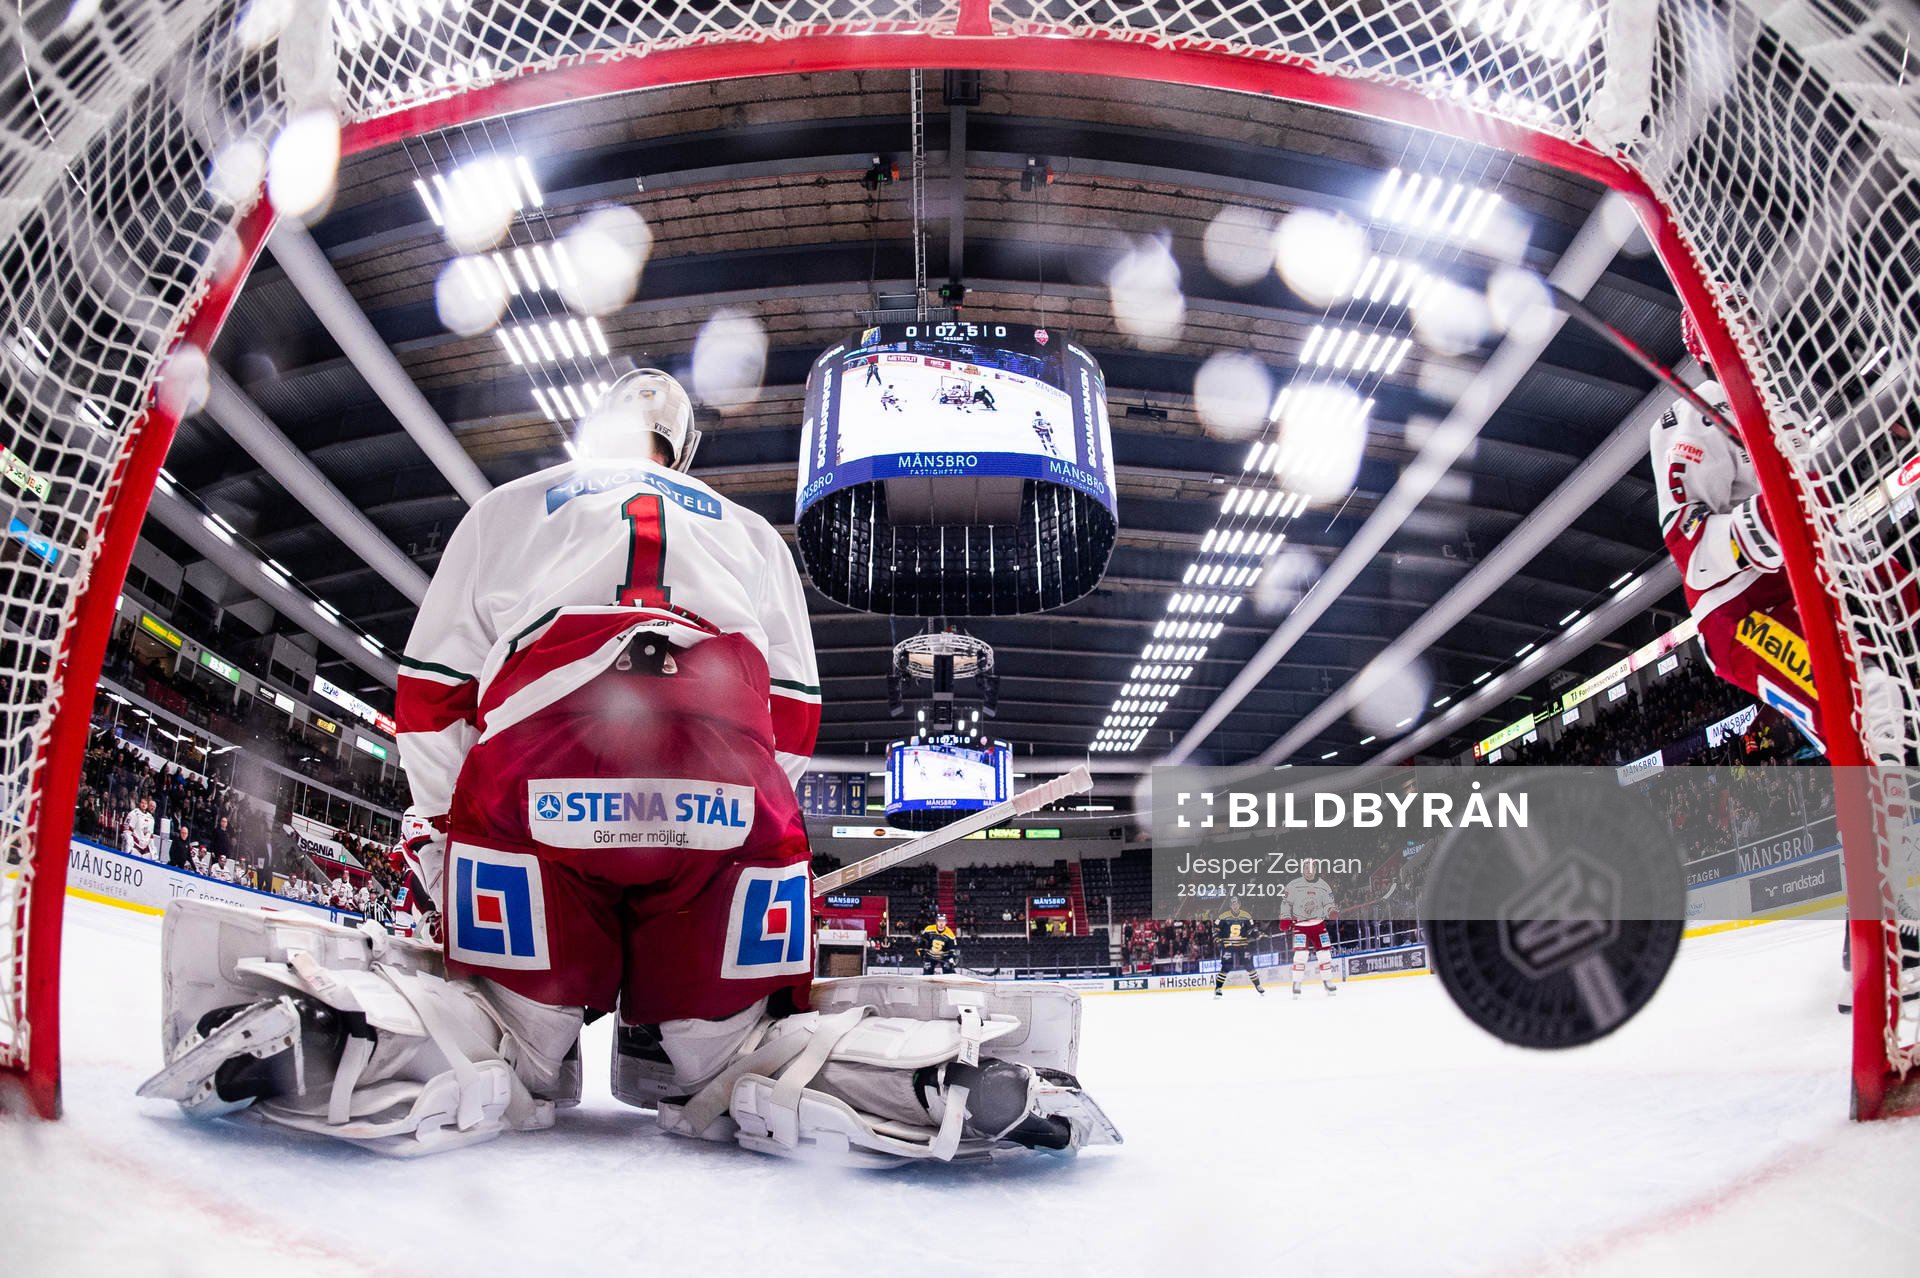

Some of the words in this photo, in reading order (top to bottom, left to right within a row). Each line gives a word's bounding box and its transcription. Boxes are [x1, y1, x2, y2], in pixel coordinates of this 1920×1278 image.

[906, 326, 917, 337] 0
[935, 326, 978, 337] 07.5
[995, 326, 1006, 337] 0
[898, 453, 977, 468] MÅNSBRO
[1050, 461, 1105, 495] MÅNSBRO
[615, 492, 671, 606] 1
[1623, 756, 1657, 778] MÅNSBRO
[567, 792, 669, 822] STENA
[676, 787, 747, 828] STÅL
[593, 829, 616, 844] Gör
[619, 831, 643, 843] mer
[646, 830, 689, 845] möjligt.
[300, 839, 334, 858] SCANIA
[1739, 833, 1814, 874] MÅNSBRO
[69, 849, 143, 888] MÅNSBRO
[1782, 869, 1826, 895] randstad
[828, 895, 859, 905] MÅNSBRO
[1033, 897, 1065, 906] MÅNSBRO
[1118, 980, 1145, 990] BST
[1168, 975, 1207, 988] Hisstech
